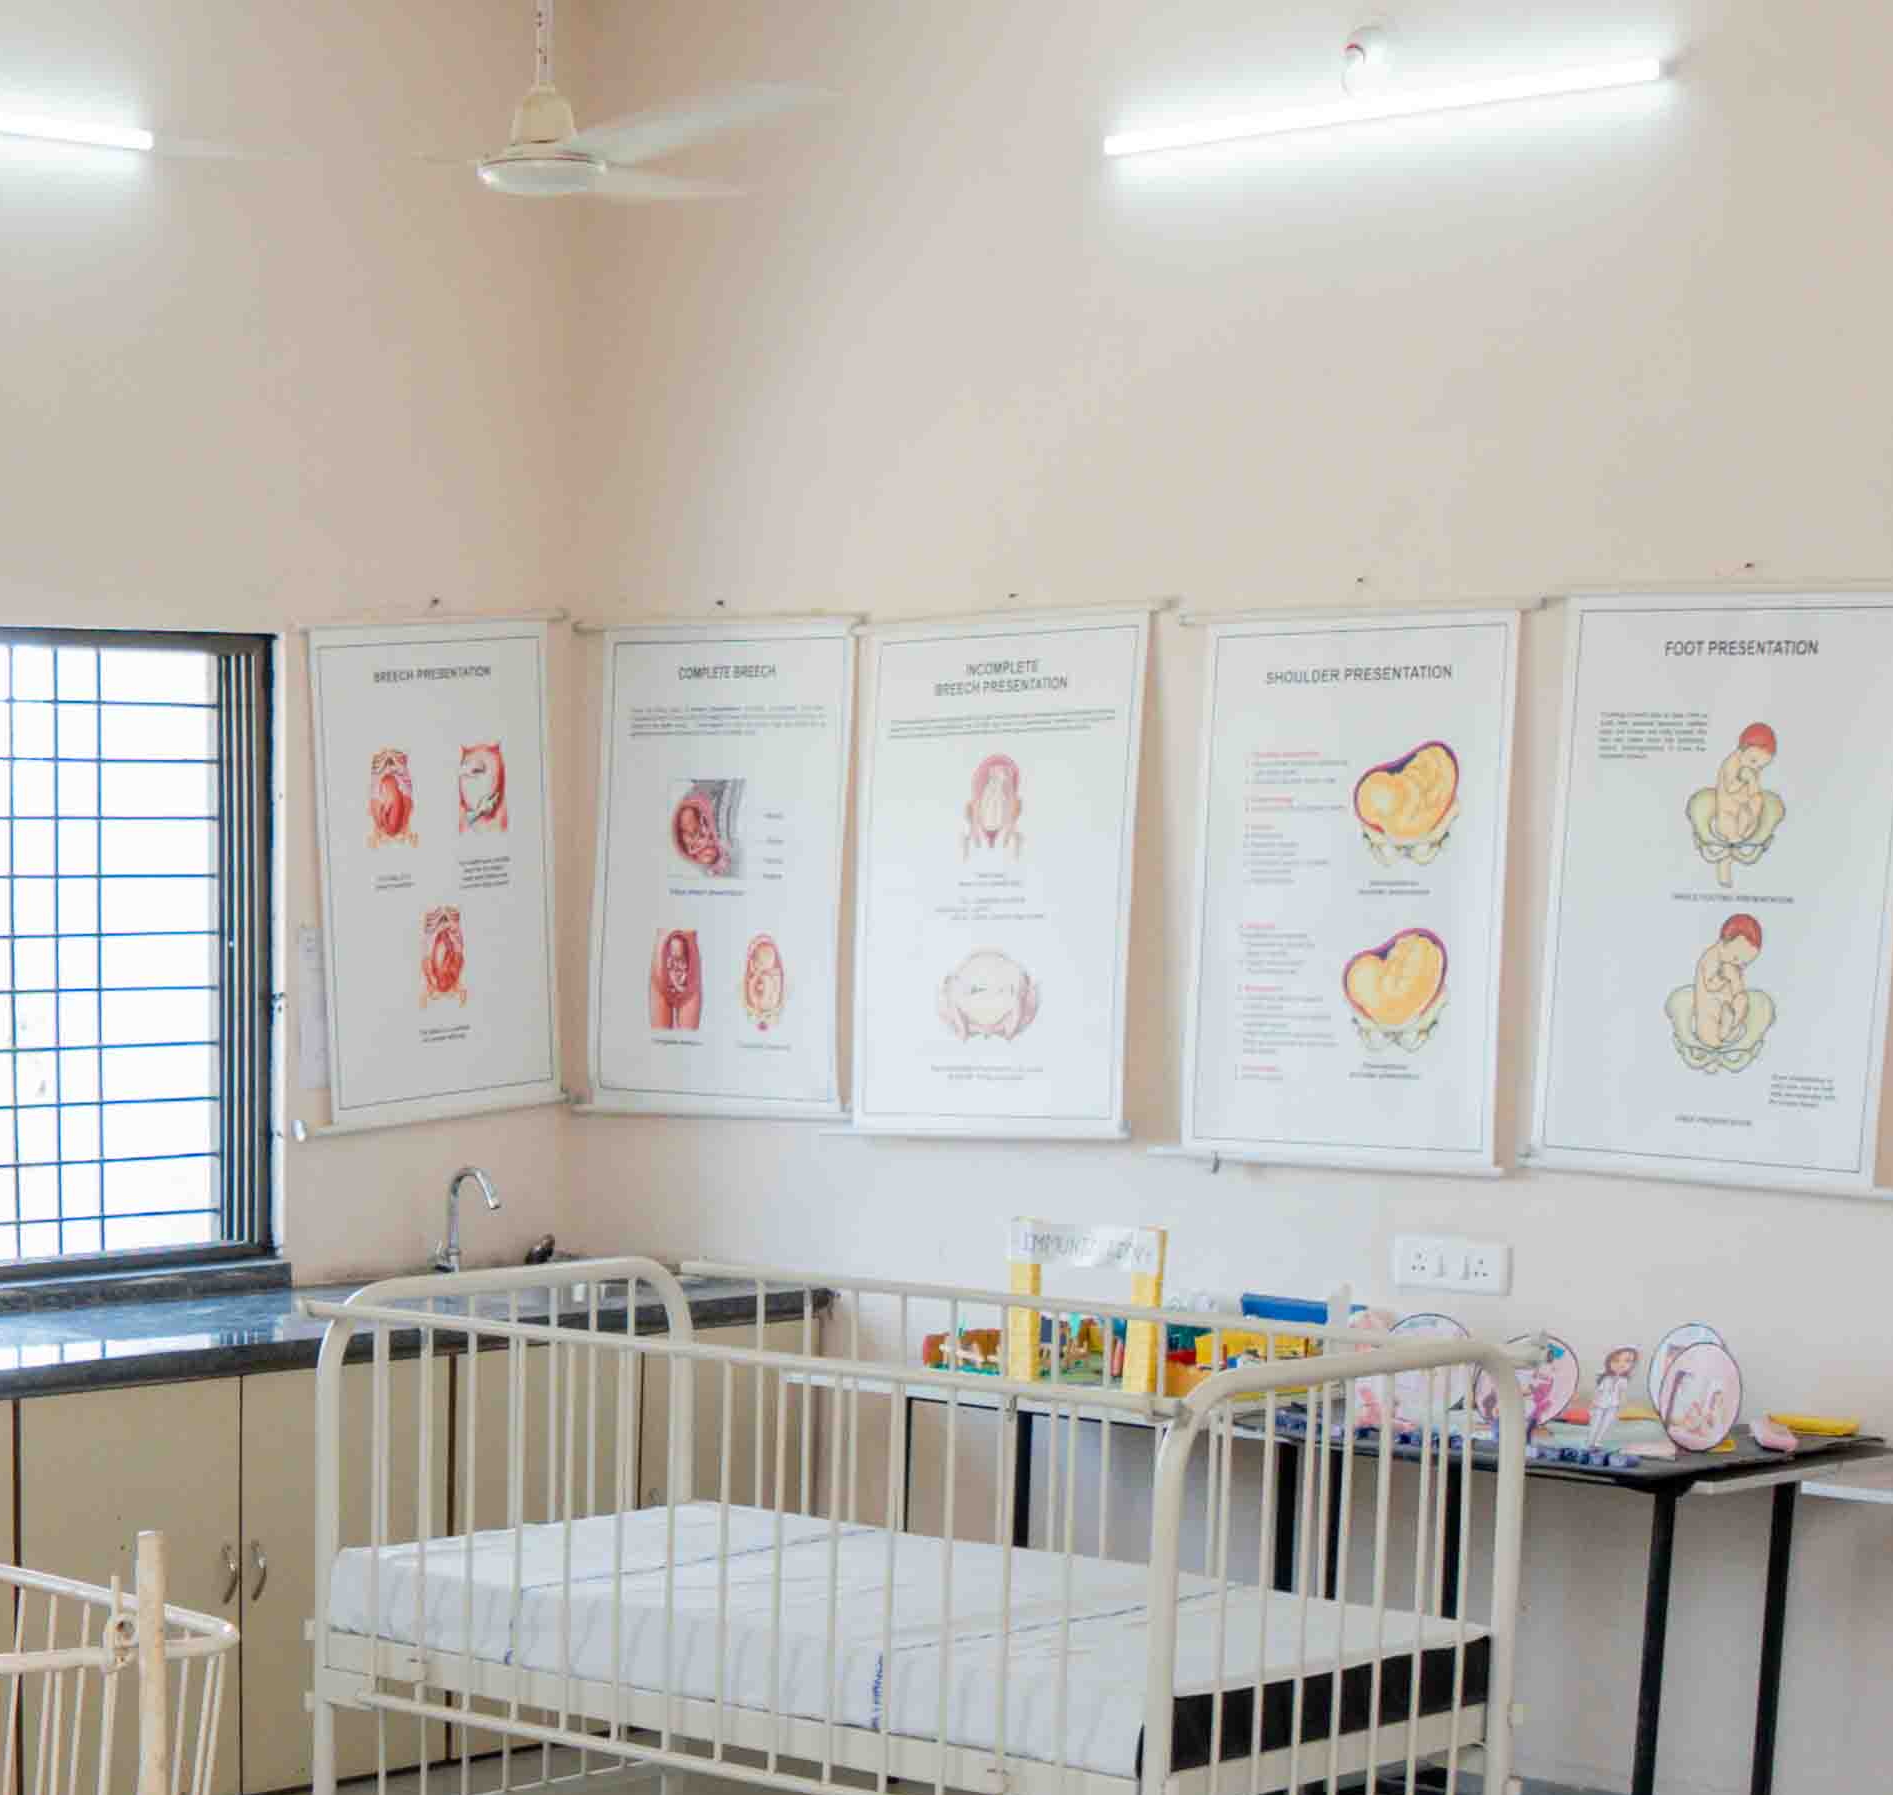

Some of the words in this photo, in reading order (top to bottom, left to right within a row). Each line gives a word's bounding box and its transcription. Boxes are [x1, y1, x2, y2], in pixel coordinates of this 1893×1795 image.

[1664, 641, 1704, 656] FOOT
[1708, 639, 1819, 657] PRESENTATION
[373, 668, 413, 683] BREECH
[678, 665, 731, 680] COMPLETE
[733, 664, 777, 679] BREECH
[966, 660, 1039, 676] INCOMPLETE
[1266, 668, 1339, 685] SHOULDER
[1344, 665, 1453, 683] PRESENTATION
[934, 681, 981, 697] BREECH
[982, 677, 1068, 694] PRESENTATION
